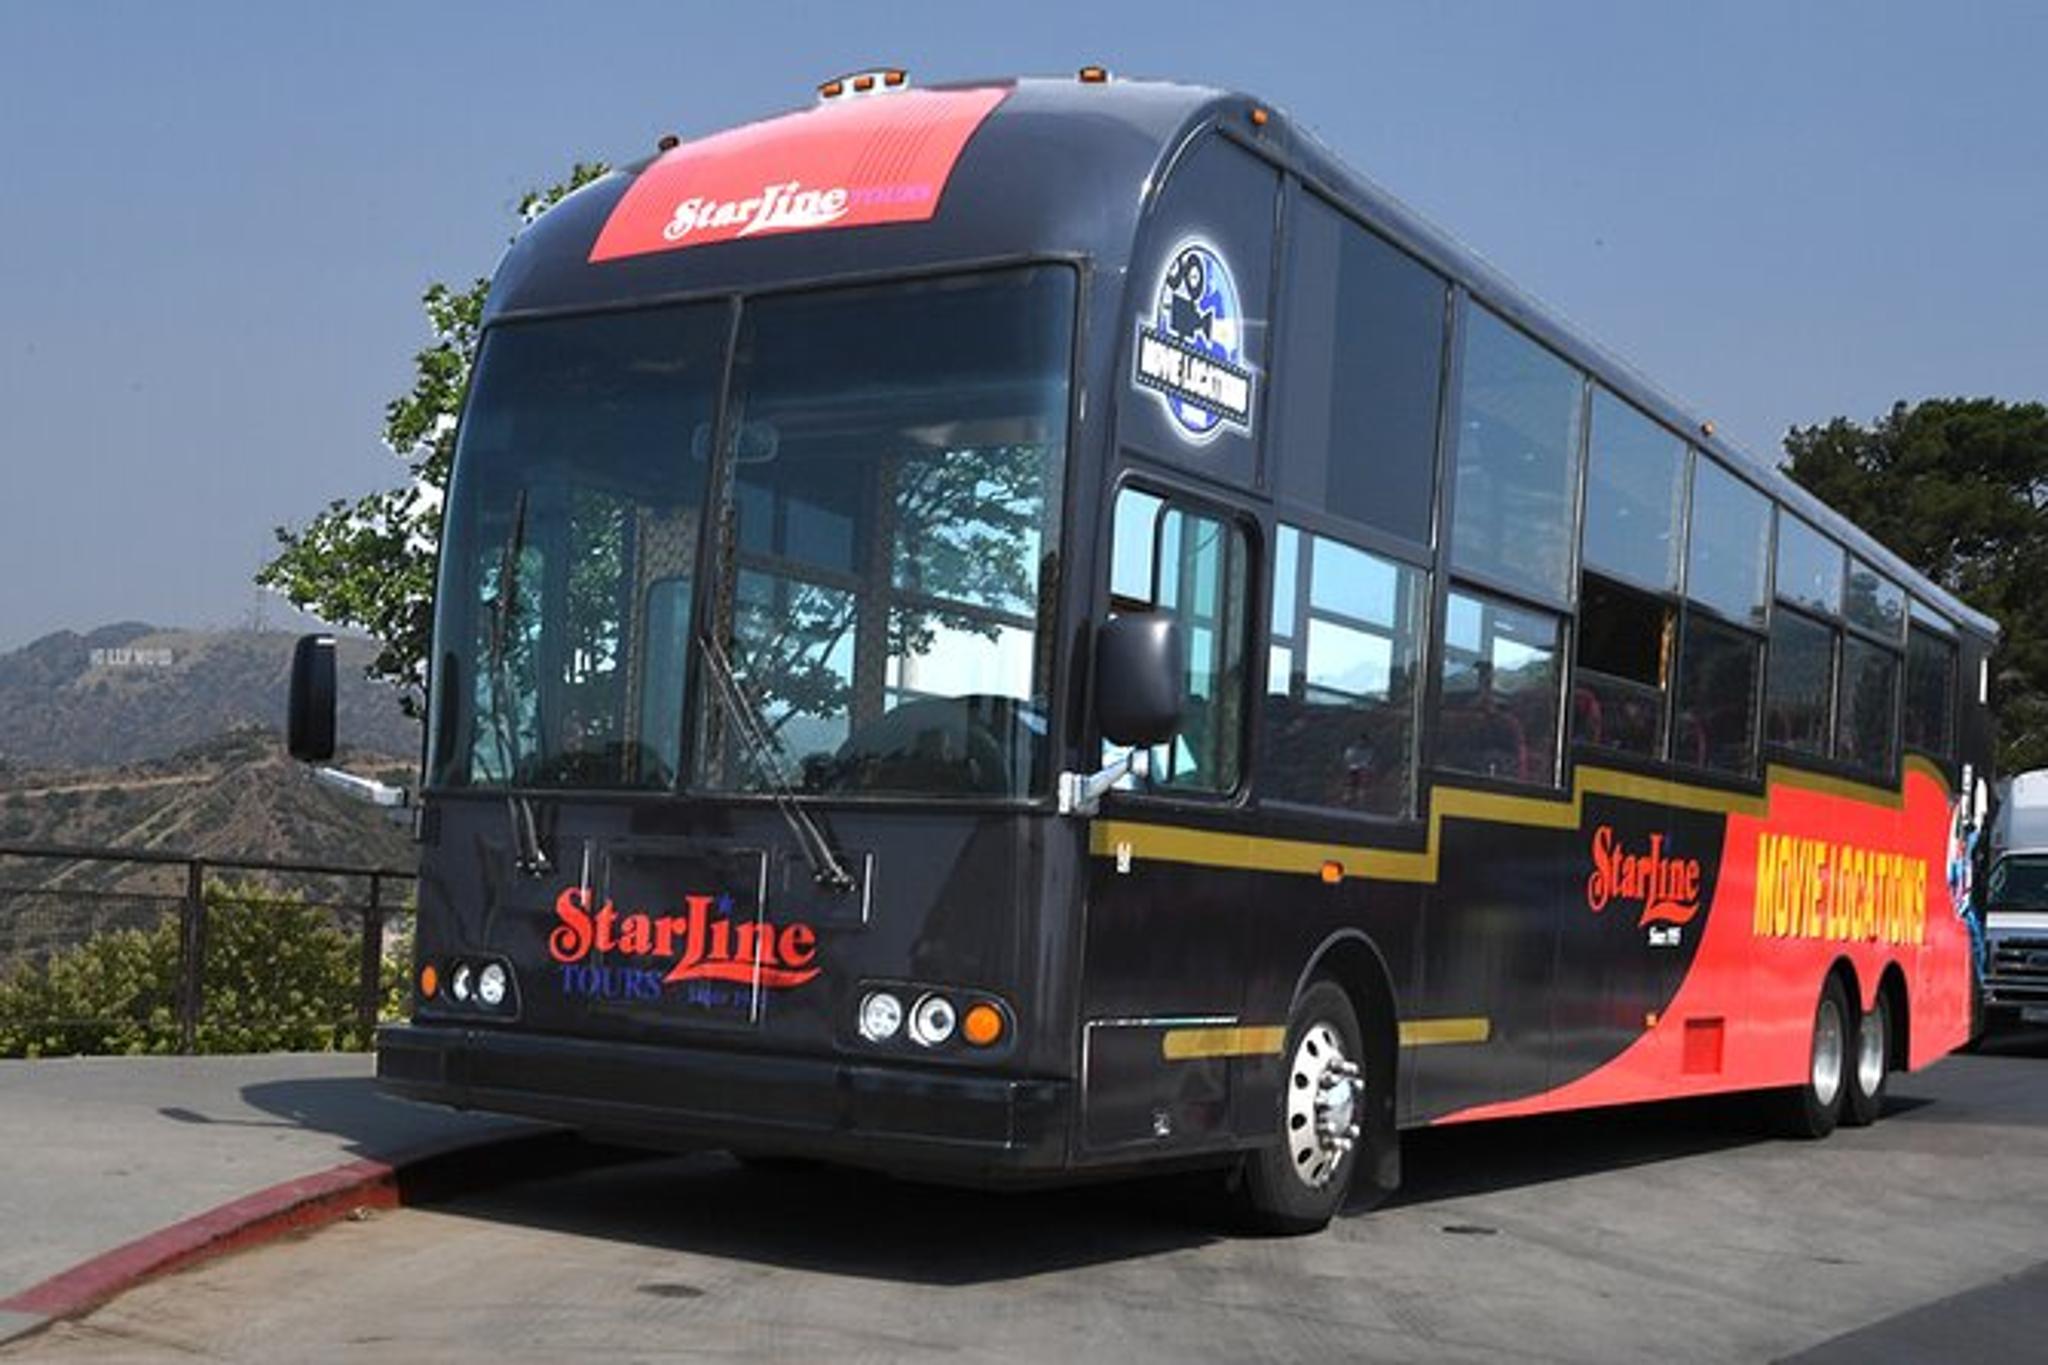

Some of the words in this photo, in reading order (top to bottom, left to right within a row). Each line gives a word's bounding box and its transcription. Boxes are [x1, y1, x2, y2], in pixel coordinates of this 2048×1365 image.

[663, 182, 849, 240] StarLine
[1588, 825, 1699, 928] StarLine
[1753, 832, 1826, 938] MOVIE
[1825, 843, 1927, 946] LOCATIONS
[549, 886, 822, 988] StarLine
[562, 963, 663, 1000] TOURS
